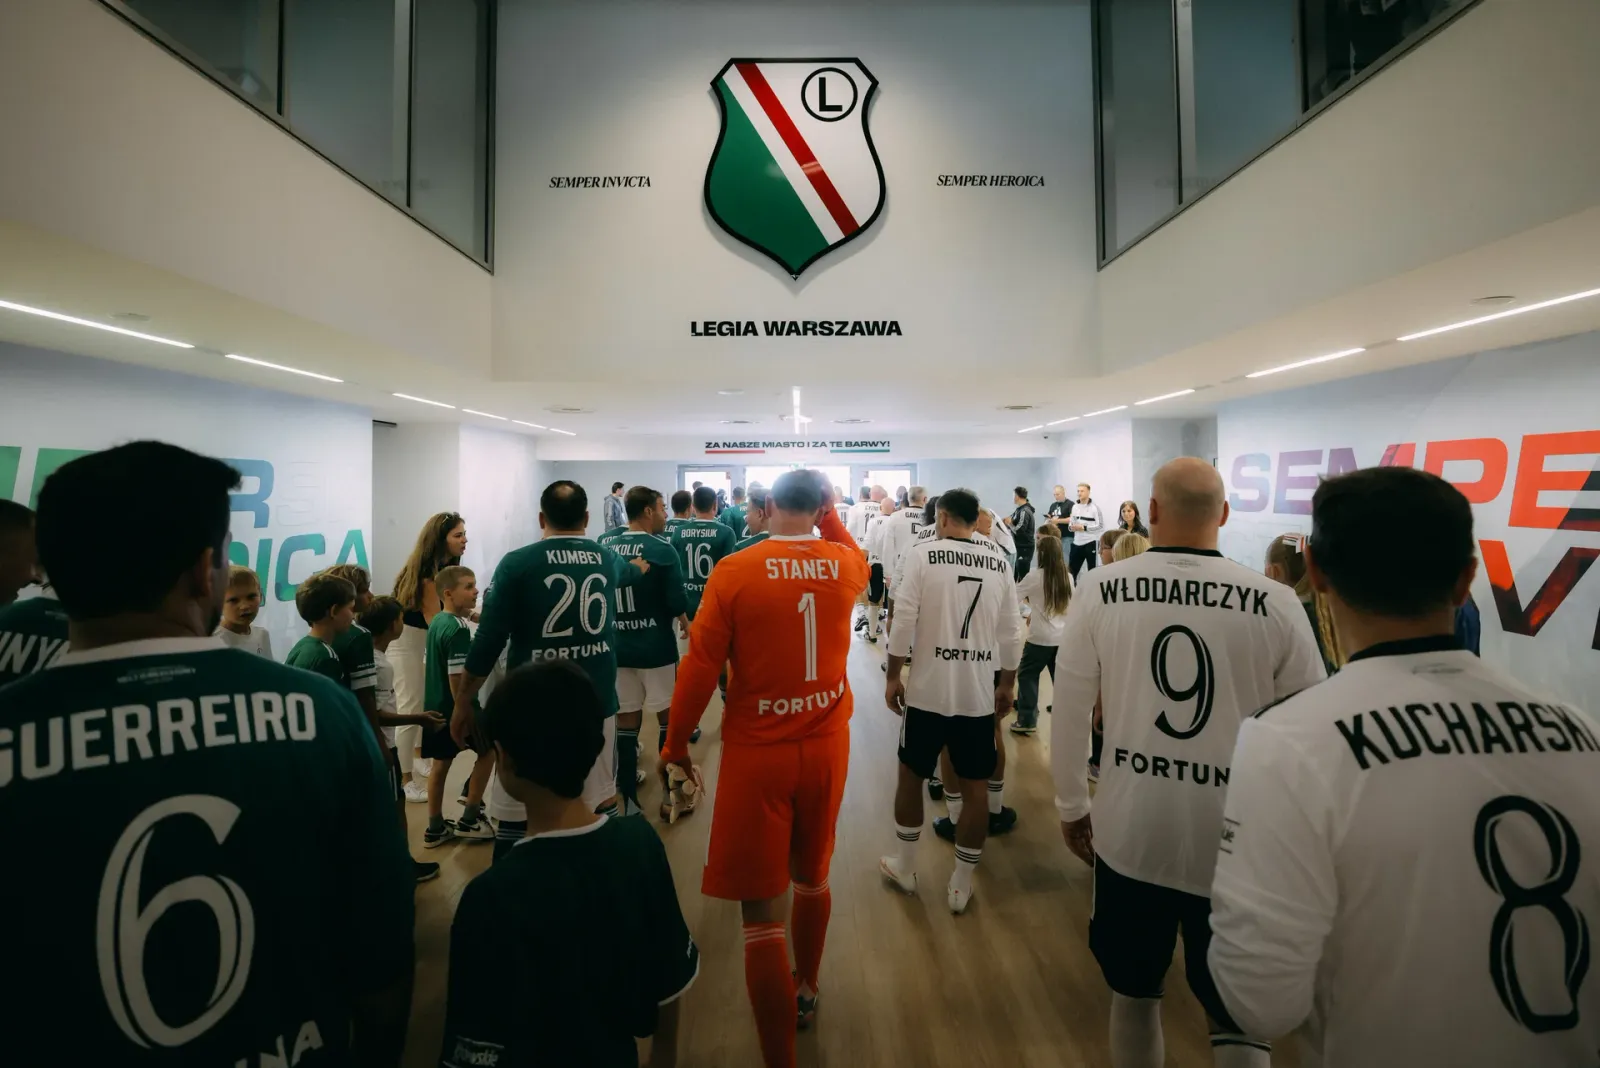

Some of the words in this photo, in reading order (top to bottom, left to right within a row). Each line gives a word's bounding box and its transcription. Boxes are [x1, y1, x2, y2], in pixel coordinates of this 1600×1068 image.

[819, 77, 842, 112] L
[549, 176, 600, 189] SEMPER
[601, 176, 651, 189] INVICTA
[936, 174, 988, 188] SEMPER
[989, 174, 1045, 188] HEROICA
[690, 321, 759, 337] LEGIA
[763, 321, 903, 337] WARSZAWA
[705, 441, 721, 449] ZA
[844, 440, 891, 448] BARWY!
[681, 528, 718, 539] BORYSIUK
[546, 550, 602, 566] KUMBEV
[685, 543, 716, 580] 16
[765, 558, 840, 580] STANEV
[928, 550, 1007, 573] BRONOWICKI
[542, 573, 607, 638] 26
[957, 575, 983, 640] 7
[1100, 576, 1269, 618] WŁODARCZYK
[798, 592, 818, 681] 1
[531, 640, 611, 663] FORTUNA
[935, 646, 992, 662] FORTUNA
[1150, 624, 1215, 740] 9
[1115, 748, 1230, 787] FORTUN
[96, 794, 255, 1048] 6
[1474, 795, 1590, 1034] 8
